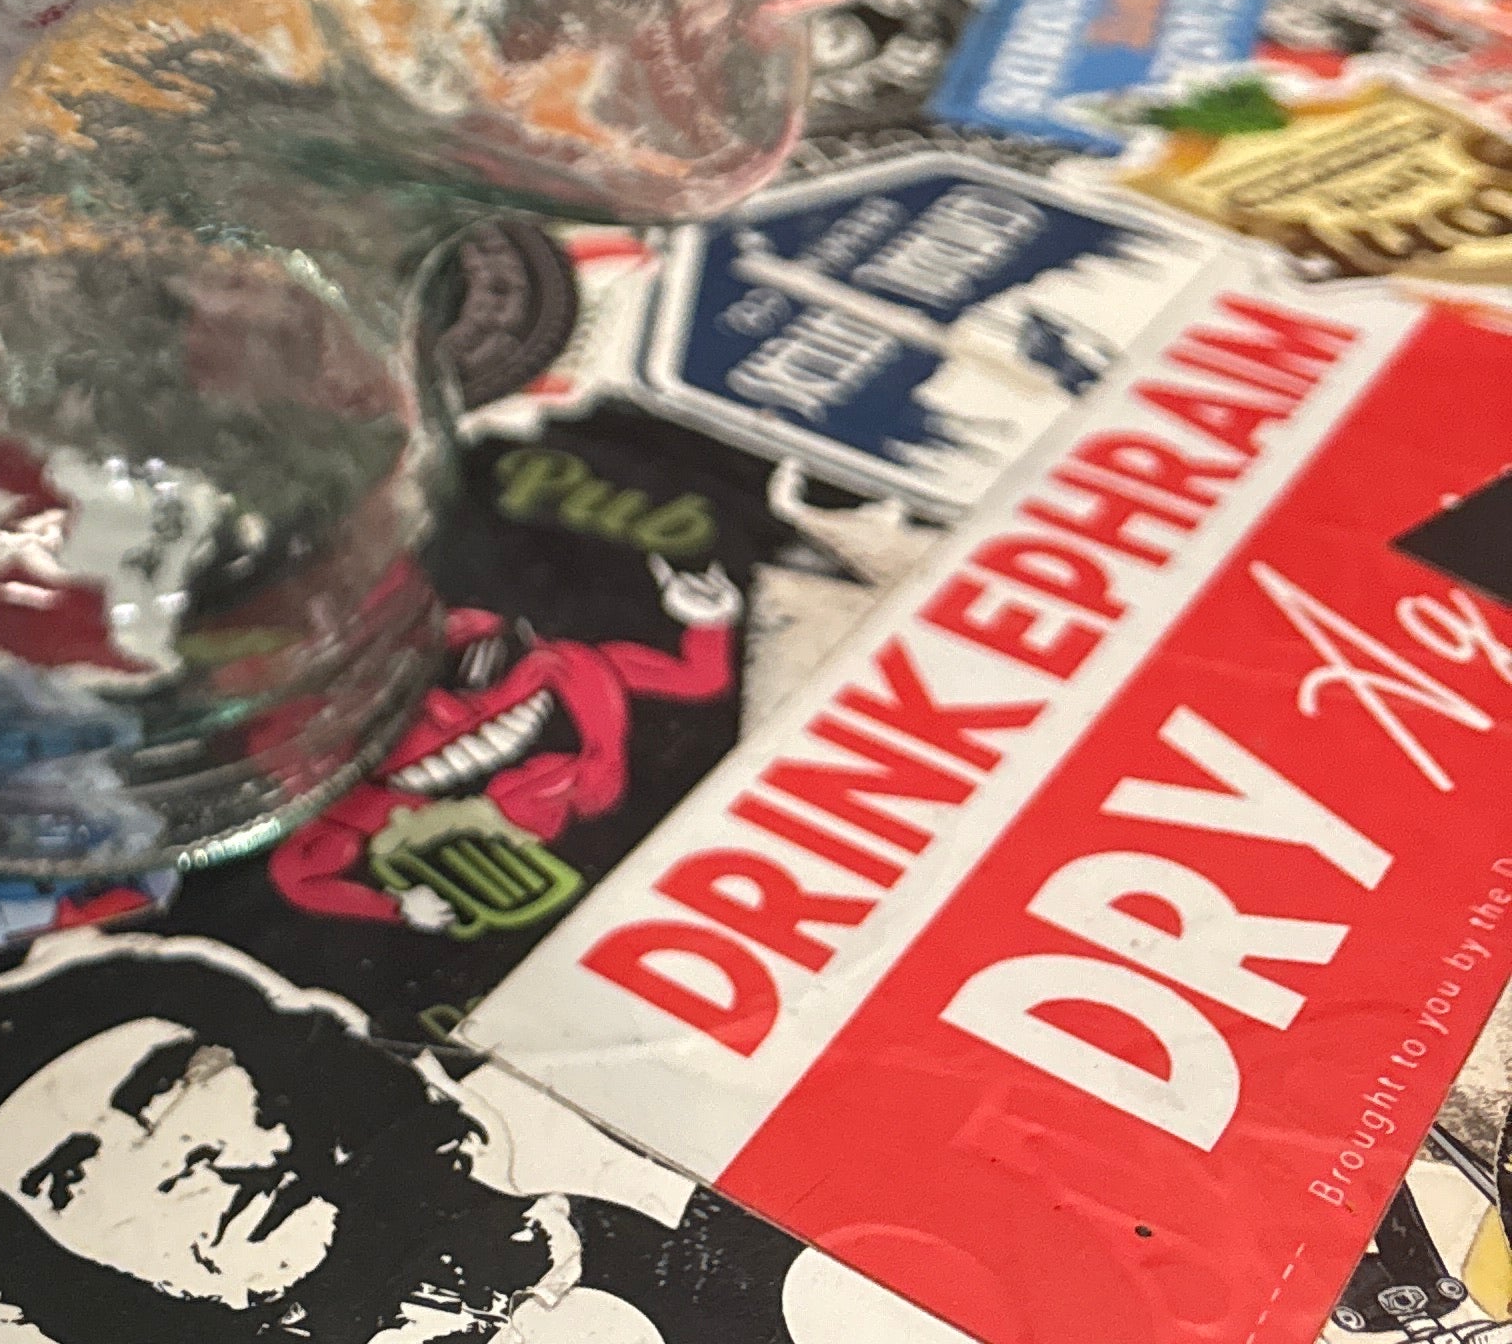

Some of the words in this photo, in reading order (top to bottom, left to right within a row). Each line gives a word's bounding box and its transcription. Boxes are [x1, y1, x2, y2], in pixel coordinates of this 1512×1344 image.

[496, 449, 716, 555] Pub
[578, 638, 1051, 1059] DRINK
[916, 293, 1364, 681] EPHRAIM
[939, 706, 1394, 1152] DRY
[1309, 1077, 1406, 1207] Brought
[1391, 1038, 1427, 1069] to
[1420, 978, 1460, 1036] you
[1442, 937, 1492, 972] by
[1469, 887, 1512, 931] the
